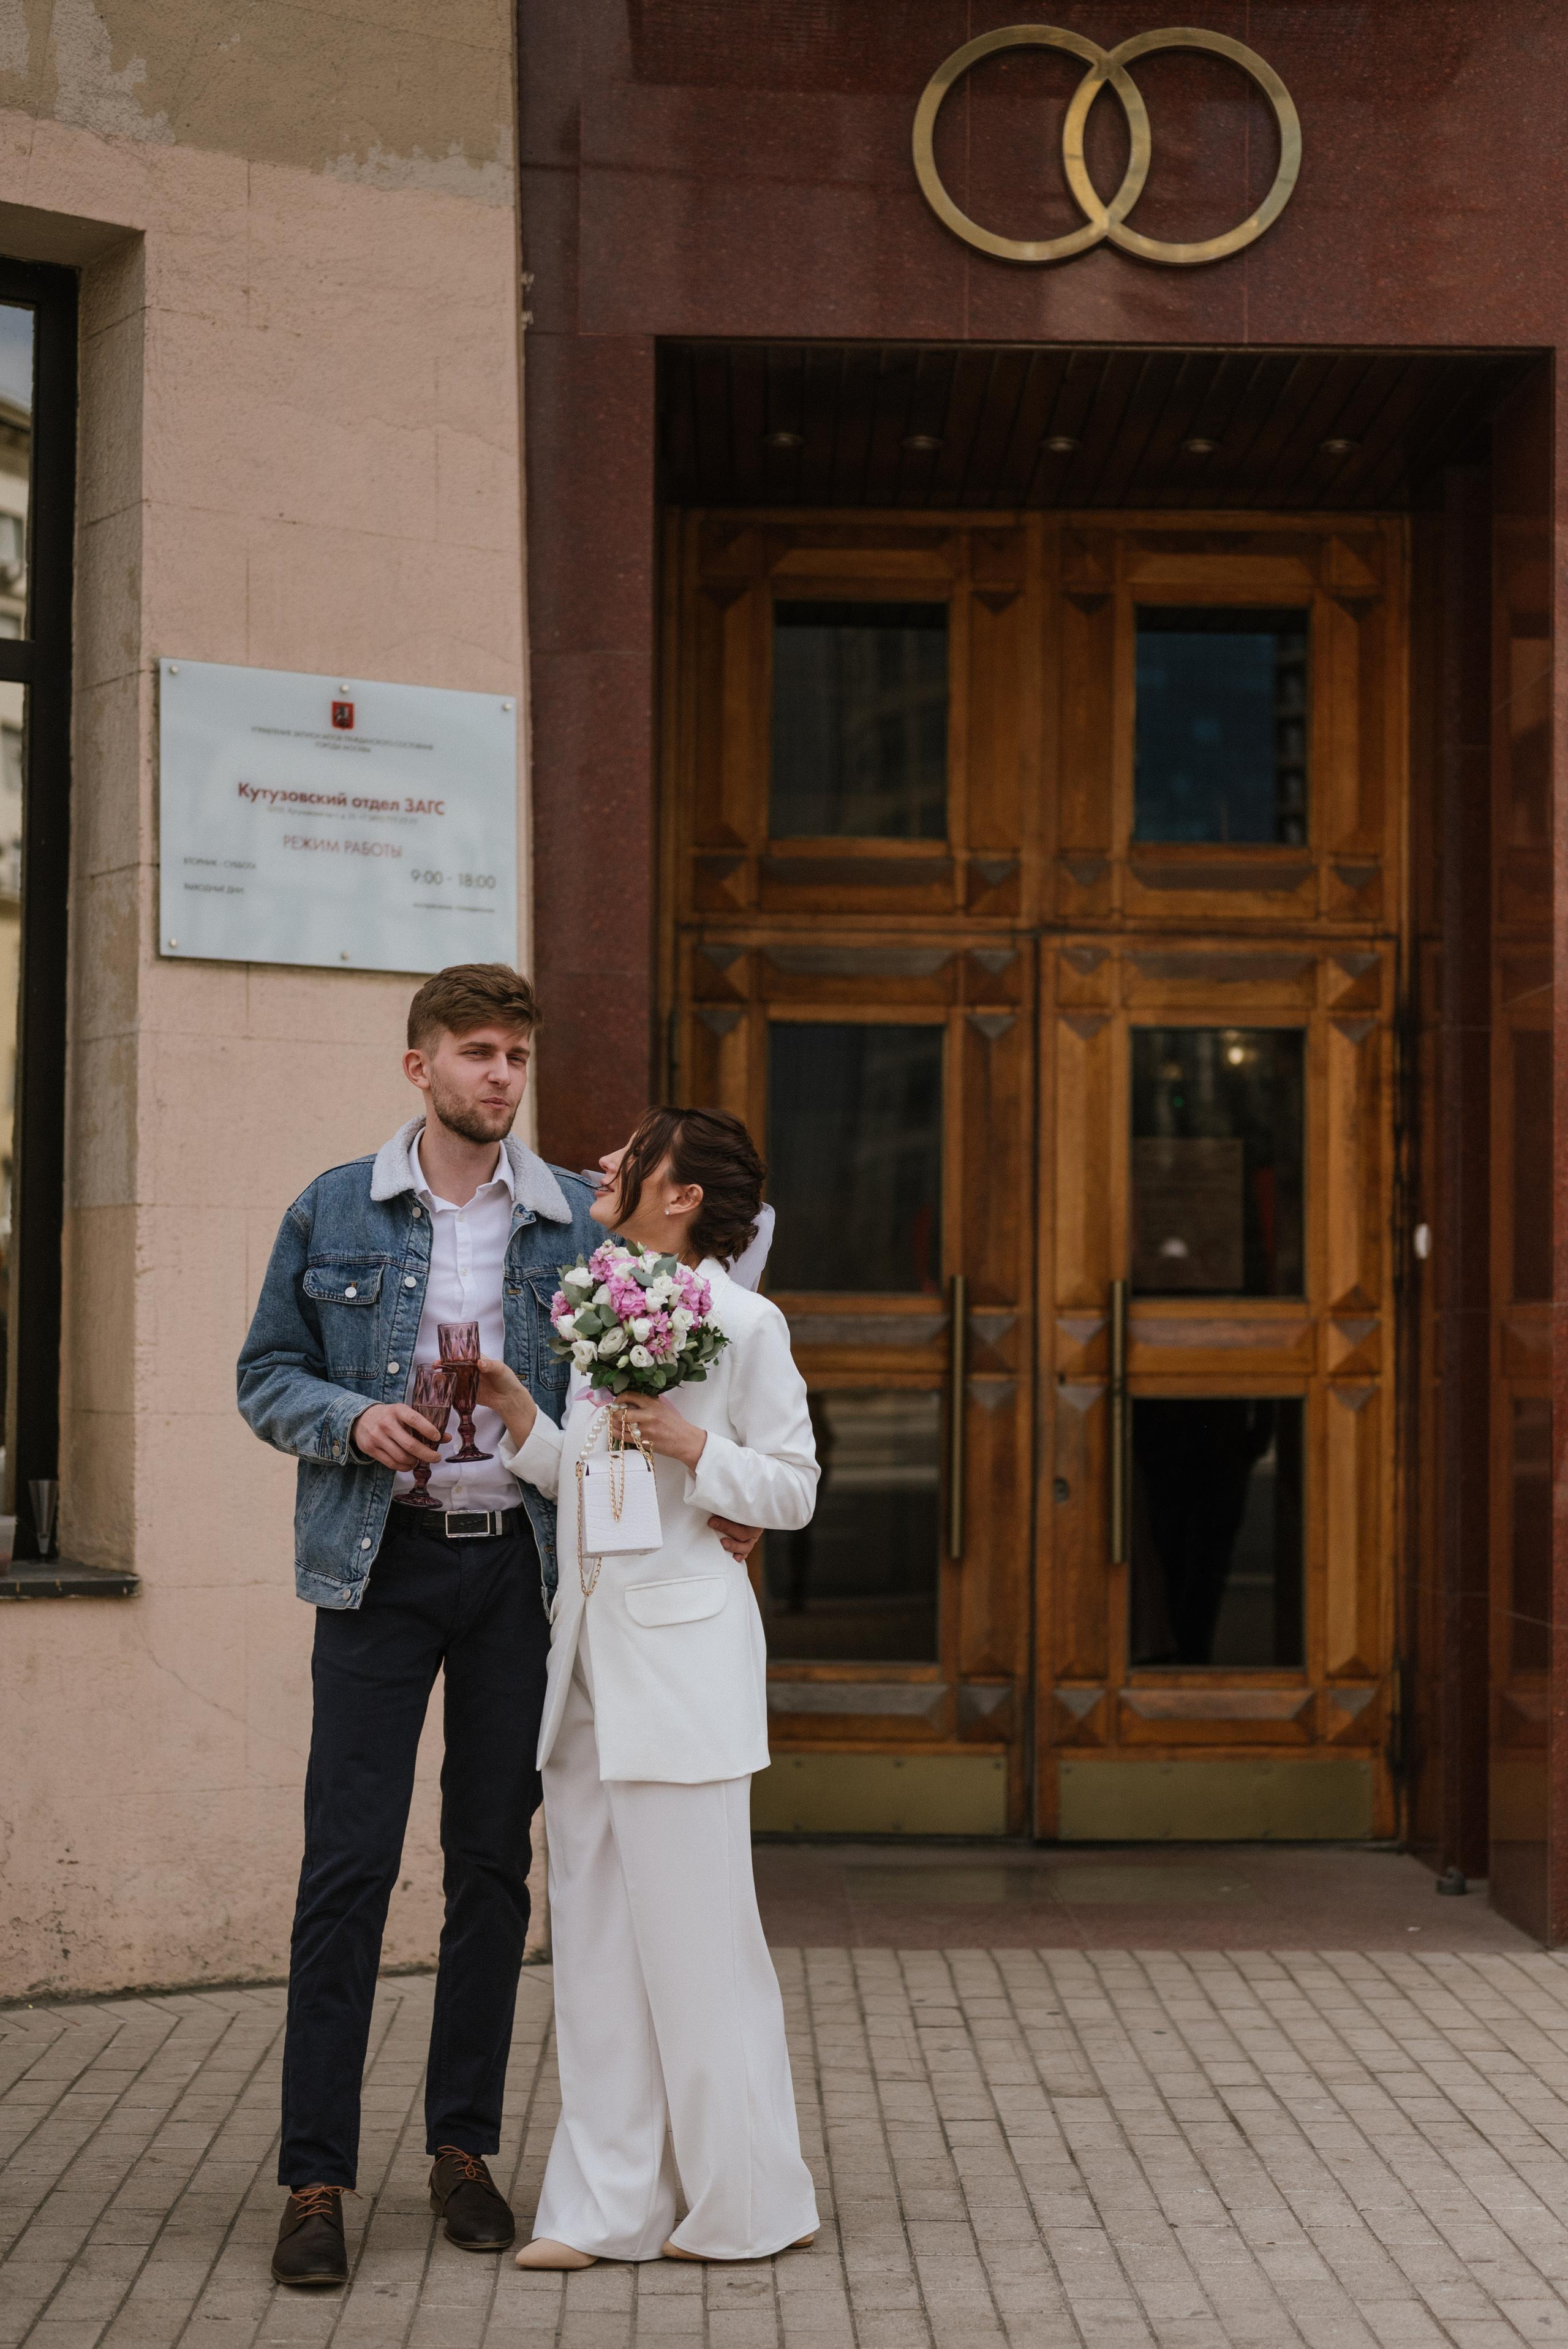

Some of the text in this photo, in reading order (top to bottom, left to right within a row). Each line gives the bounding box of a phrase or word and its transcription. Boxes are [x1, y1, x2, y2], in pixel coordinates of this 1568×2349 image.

[238, 781, 445, 815] Кутузовский отдел ЗАГС
[284, 834, 402, 858] РЕЖИМ РАБОТЫ
